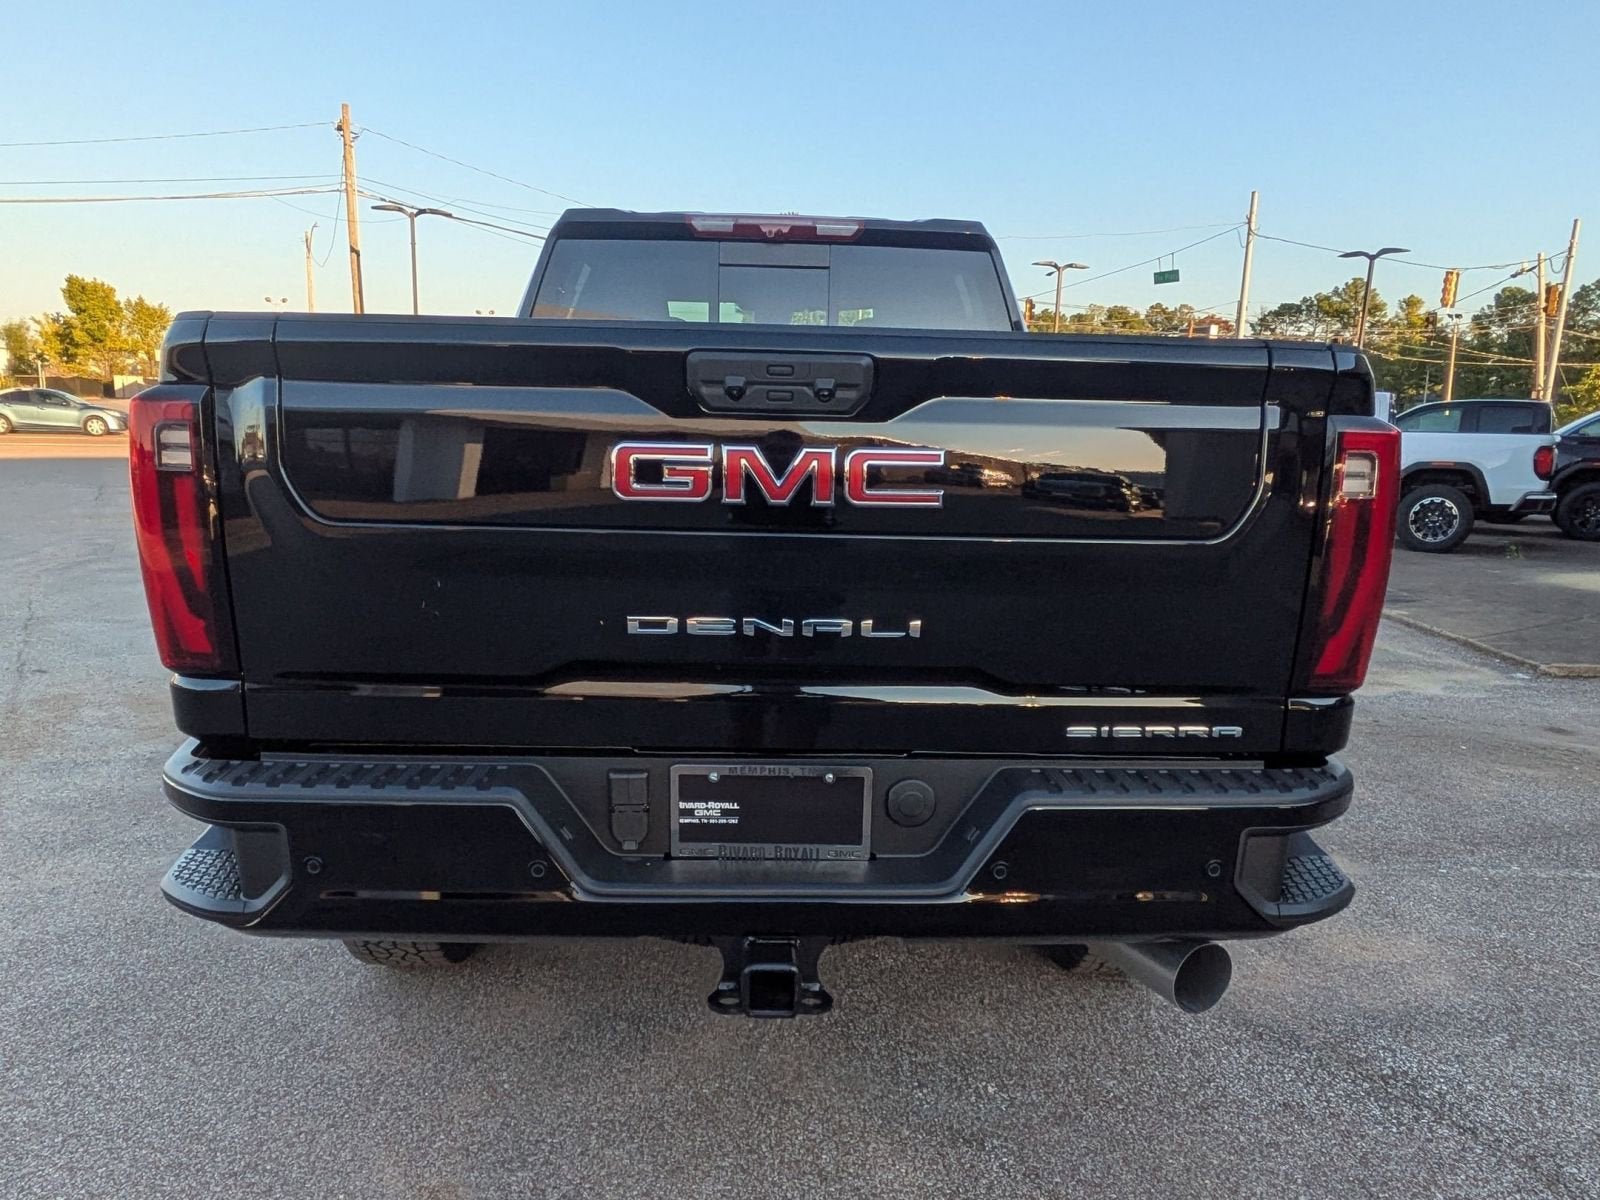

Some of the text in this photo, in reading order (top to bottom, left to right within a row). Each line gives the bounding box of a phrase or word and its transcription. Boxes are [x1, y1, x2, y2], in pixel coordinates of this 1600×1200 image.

[611, 441, 946, 509] GMC
[626, 615, 922, 639] DENALI
[1065, 725, 1243, 738] SIERRA
[827, 849, 862, 859] GMC
